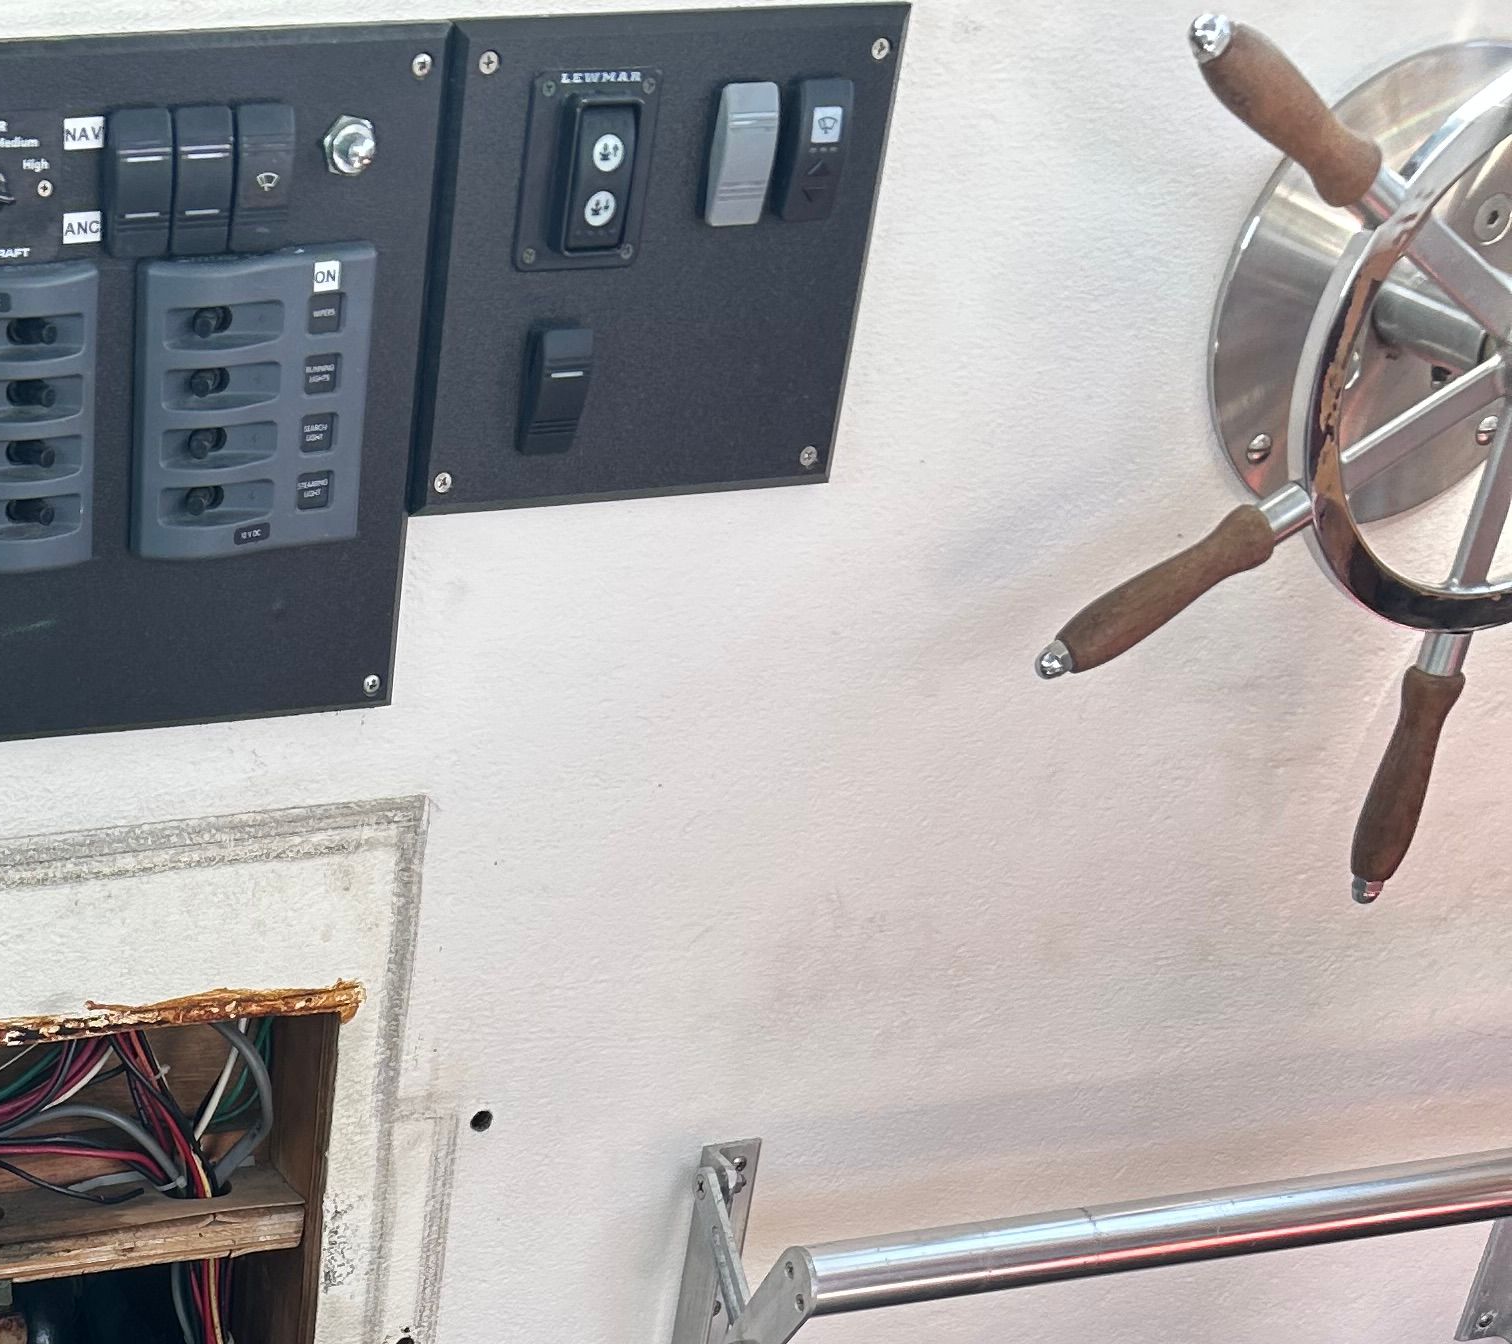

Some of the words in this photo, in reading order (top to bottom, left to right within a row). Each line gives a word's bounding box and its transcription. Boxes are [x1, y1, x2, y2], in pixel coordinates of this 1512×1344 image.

[560, 71, 642, 84] LEWMAR
[65, 126, 102, 143] NAV
[22, 158, 50, 173] High
[64, 219, 100, 237] ANC
[313, 269, 337, 284] ON
